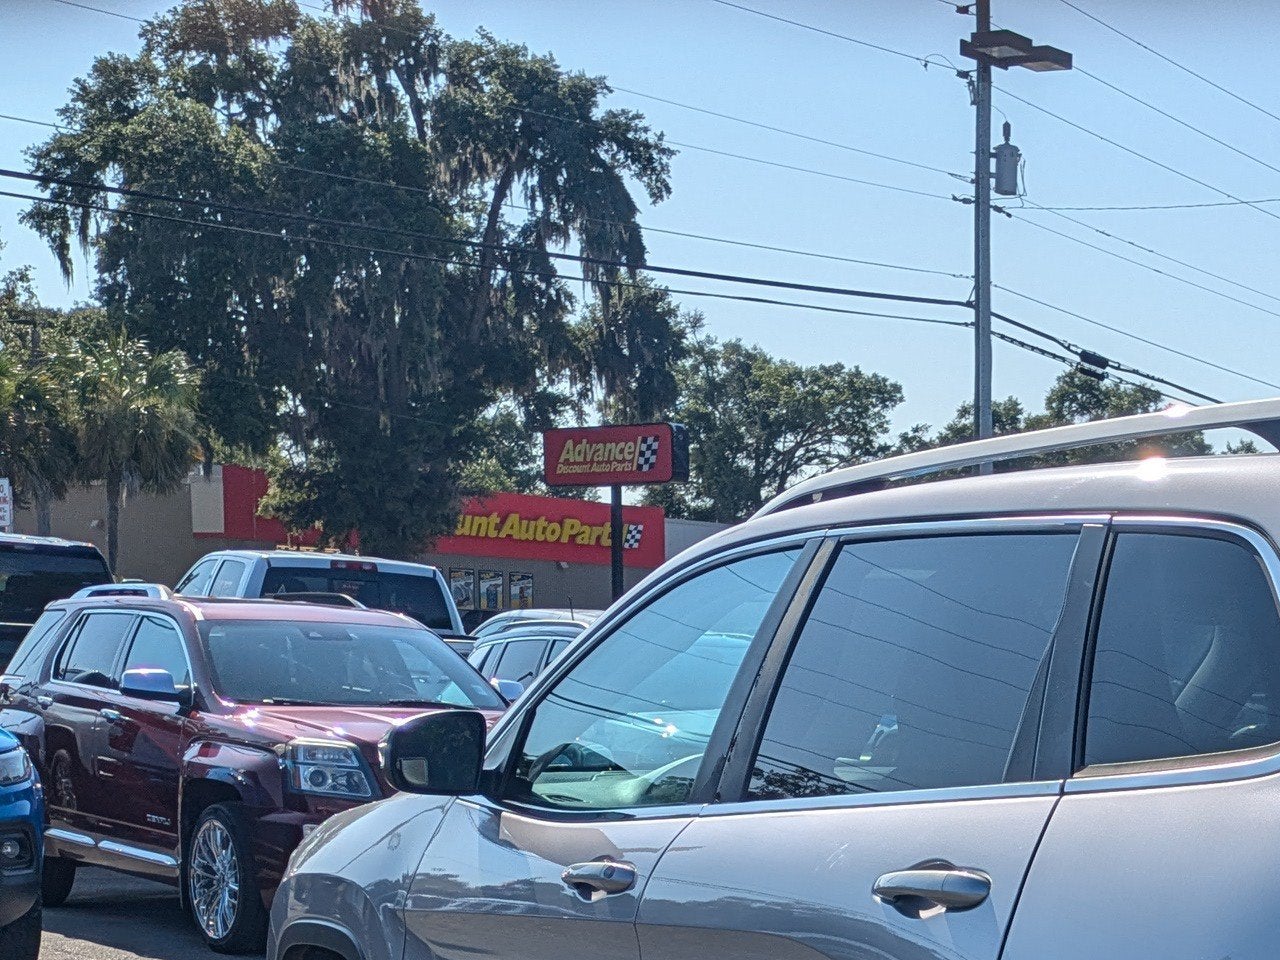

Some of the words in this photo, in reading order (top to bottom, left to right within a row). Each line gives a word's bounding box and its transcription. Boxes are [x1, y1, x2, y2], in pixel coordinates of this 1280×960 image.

[558, 439, 634, 463] Advance
[556, 463, 591, 474] Discount
[591, 462, 611, 473] Auto
[611, 461, 632, 472] Parts
[455, 513, 501, 538] unt
[561, 518, 612, 548] Part
